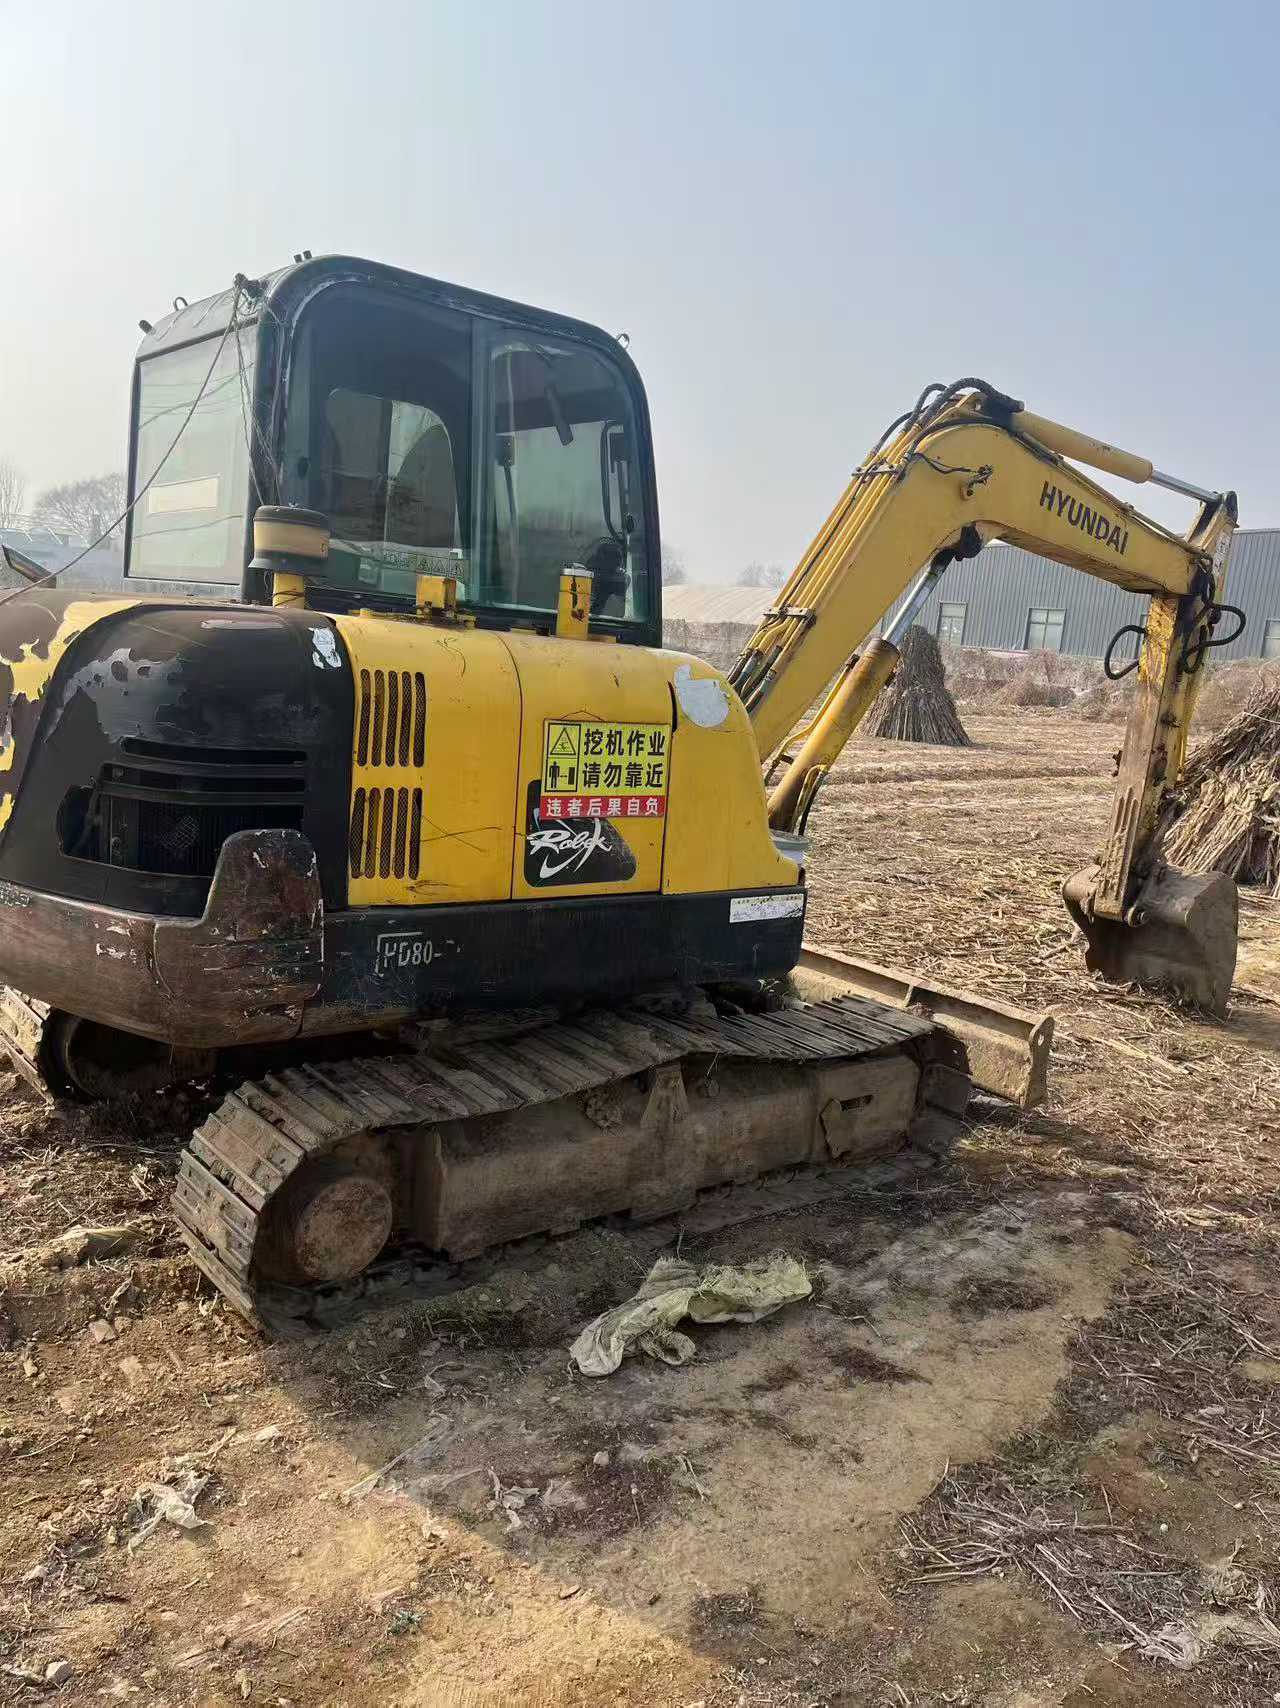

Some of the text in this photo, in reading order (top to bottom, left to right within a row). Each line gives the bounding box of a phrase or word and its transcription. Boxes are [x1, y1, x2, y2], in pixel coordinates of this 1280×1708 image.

[1040, 480, 1129, 555] HYUNDAI
[583, 728, 666, 757] 挖机作业
[582, 761, 664, 788] 请勿靠近
[546, 798, 659, 817] 违者后果自负
